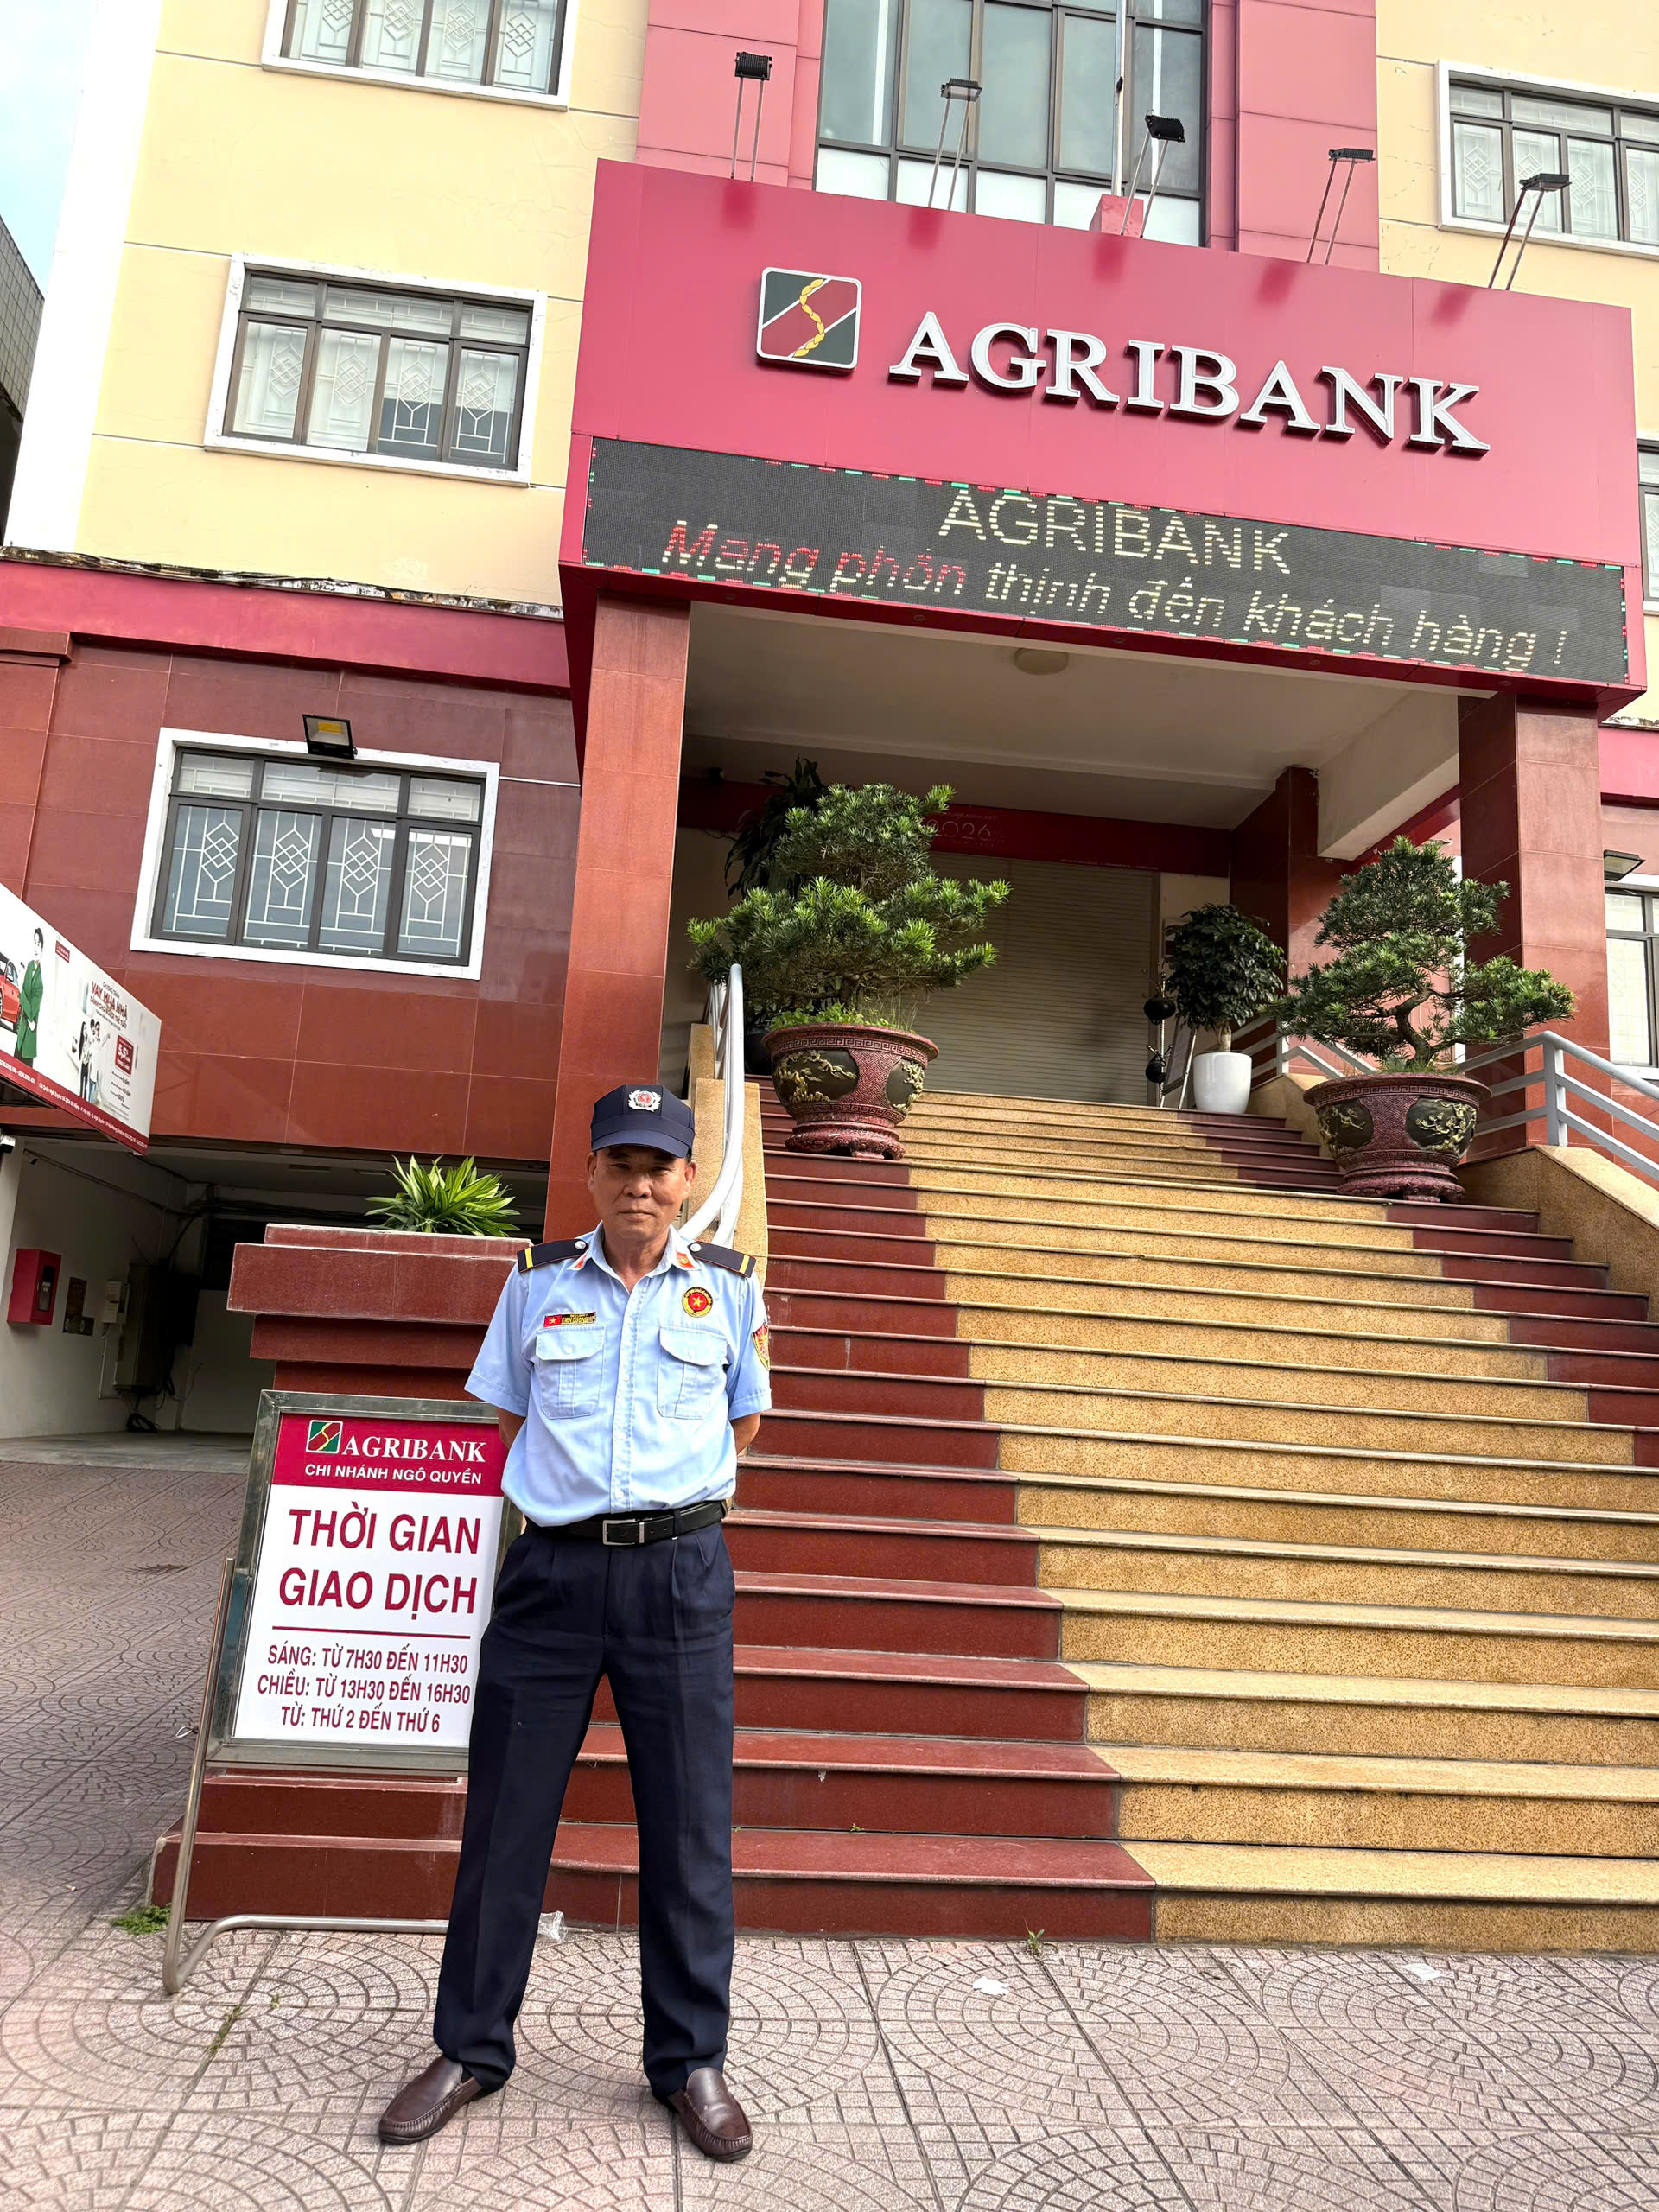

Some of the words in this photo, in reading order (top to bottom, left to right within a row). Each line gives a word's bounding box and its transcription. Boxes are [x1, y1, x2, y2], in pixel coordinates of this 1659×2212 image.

[888, 311, 1490, 456] AGRIBANK
[939, 489, 1290, 575] AGRIBANK
[662, 520, 819, 588] Mang
[1243, 590, 1393, 645] khách
[342, 1434, 486, 1463] AGRIBANK
[305, 1464, 331, 1477] CHI
[335, 1464, 388, 1479] NHÁNH
[392, 1466, 427, 1480] NGÔ
[429, 1467, 482, 1484] QUYỀN
[289, 1501, 378, 1550] THỜI
[389, 1513, 482, 1554] GIAN
[279, 1567, 374, 1609] GIAO
[385, 1573, 477, 1620] DỊCH
[267, 1640, 316, 1666] SÁNG:
[322, 1643, 344, 1668] TỪ
[346, 1649, 382, 1669] 7H30
[386, 1643, 419, 1671] ĐẾN
[423, 1652, 468, 1674] 11H30
[257, 1668, 310, 1696] CHIỀU:
[315, 1673, 337, 1698] TỪ
[340, 1679, 385, 1700] 13H30
[388, 1673, 422, 1701] ĐẾN
[426, 1682, 471, 1704] 16H30
[281, 1701, 306, 1726] TỪ:
[311, 1703, 344, 1728] THỨ
[346, 1710, 355, 1728] 2
[359, 1702, 392, 1731] ĐẾN
[397, 1707, 429, 1732] THỨ
[431, 1713, 441, 1733] 6
